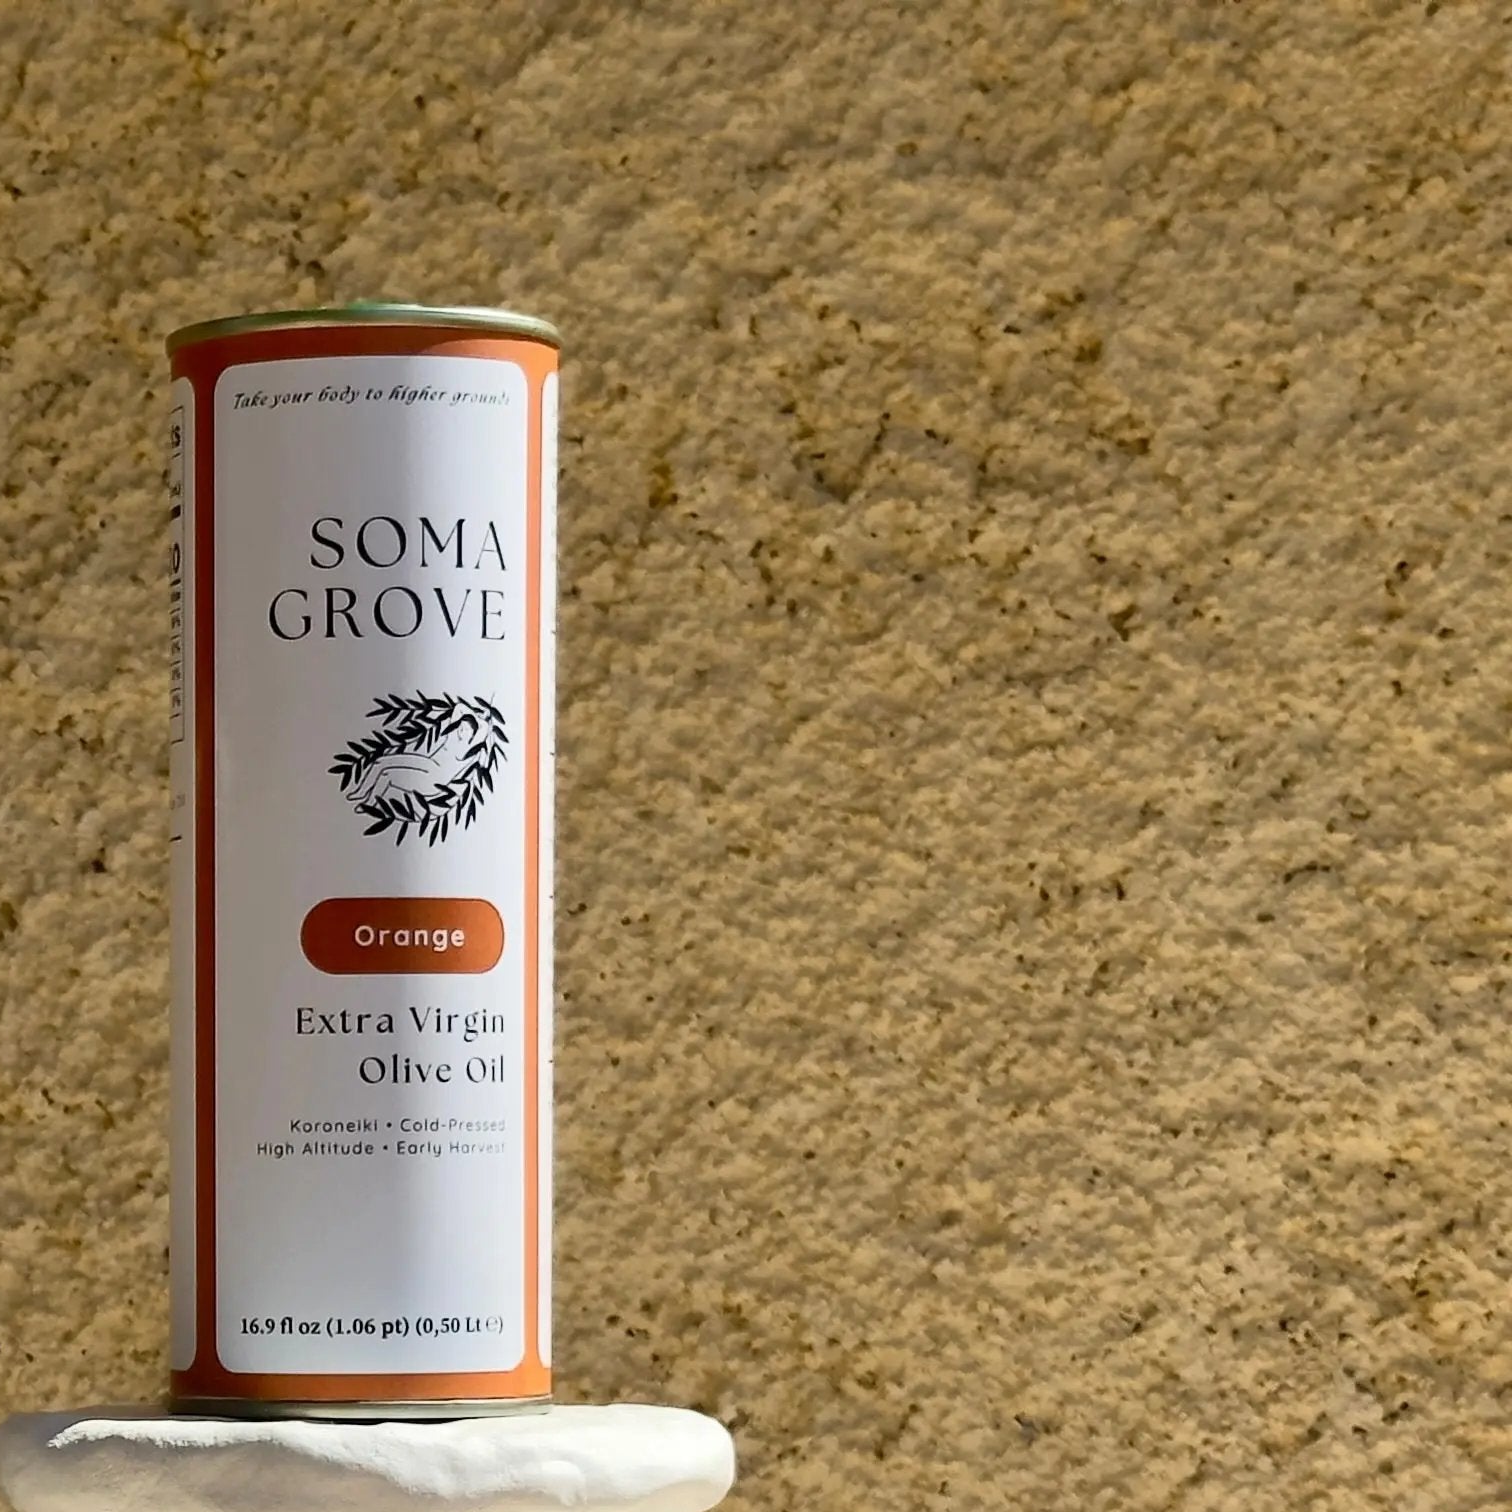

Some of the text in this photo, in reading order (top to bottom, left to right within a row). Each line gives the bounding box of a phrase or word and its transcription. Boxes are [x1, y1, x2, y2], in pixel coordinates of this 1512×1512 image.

[233, 391, 268, 410] Take
[269, 392, 313, 410] your
[318, 385, 360, 404] body
[365, 388, 383, 401] to
[388, 385, 446, 405] higher
[311, 516, 506, 571] SOMA
[269, 586, 504, 640] GROVE
[355, 925, 465, 952] Orange
[297, 1007, 504, 1042] Extra Virgin
[360, 1053, 503, 1084] Olive Oil
[290, 1118, 506, 1133] Koroneiki Cold-Pressed
[257, 1140, 505, 1159] High Altitude Early Harvest
[241, 1318, 275, 1335] 16.9
[280, 1317, 293, 1334] fl
[298, 1322, 321, 1335] oz
[327, 1317, 376, 1338] (1.06
[382, 1317, 409, 1339] pt)
[416, 1317, 460, 1337] (0,50
[466, 1317, 481, 1332] Lt
